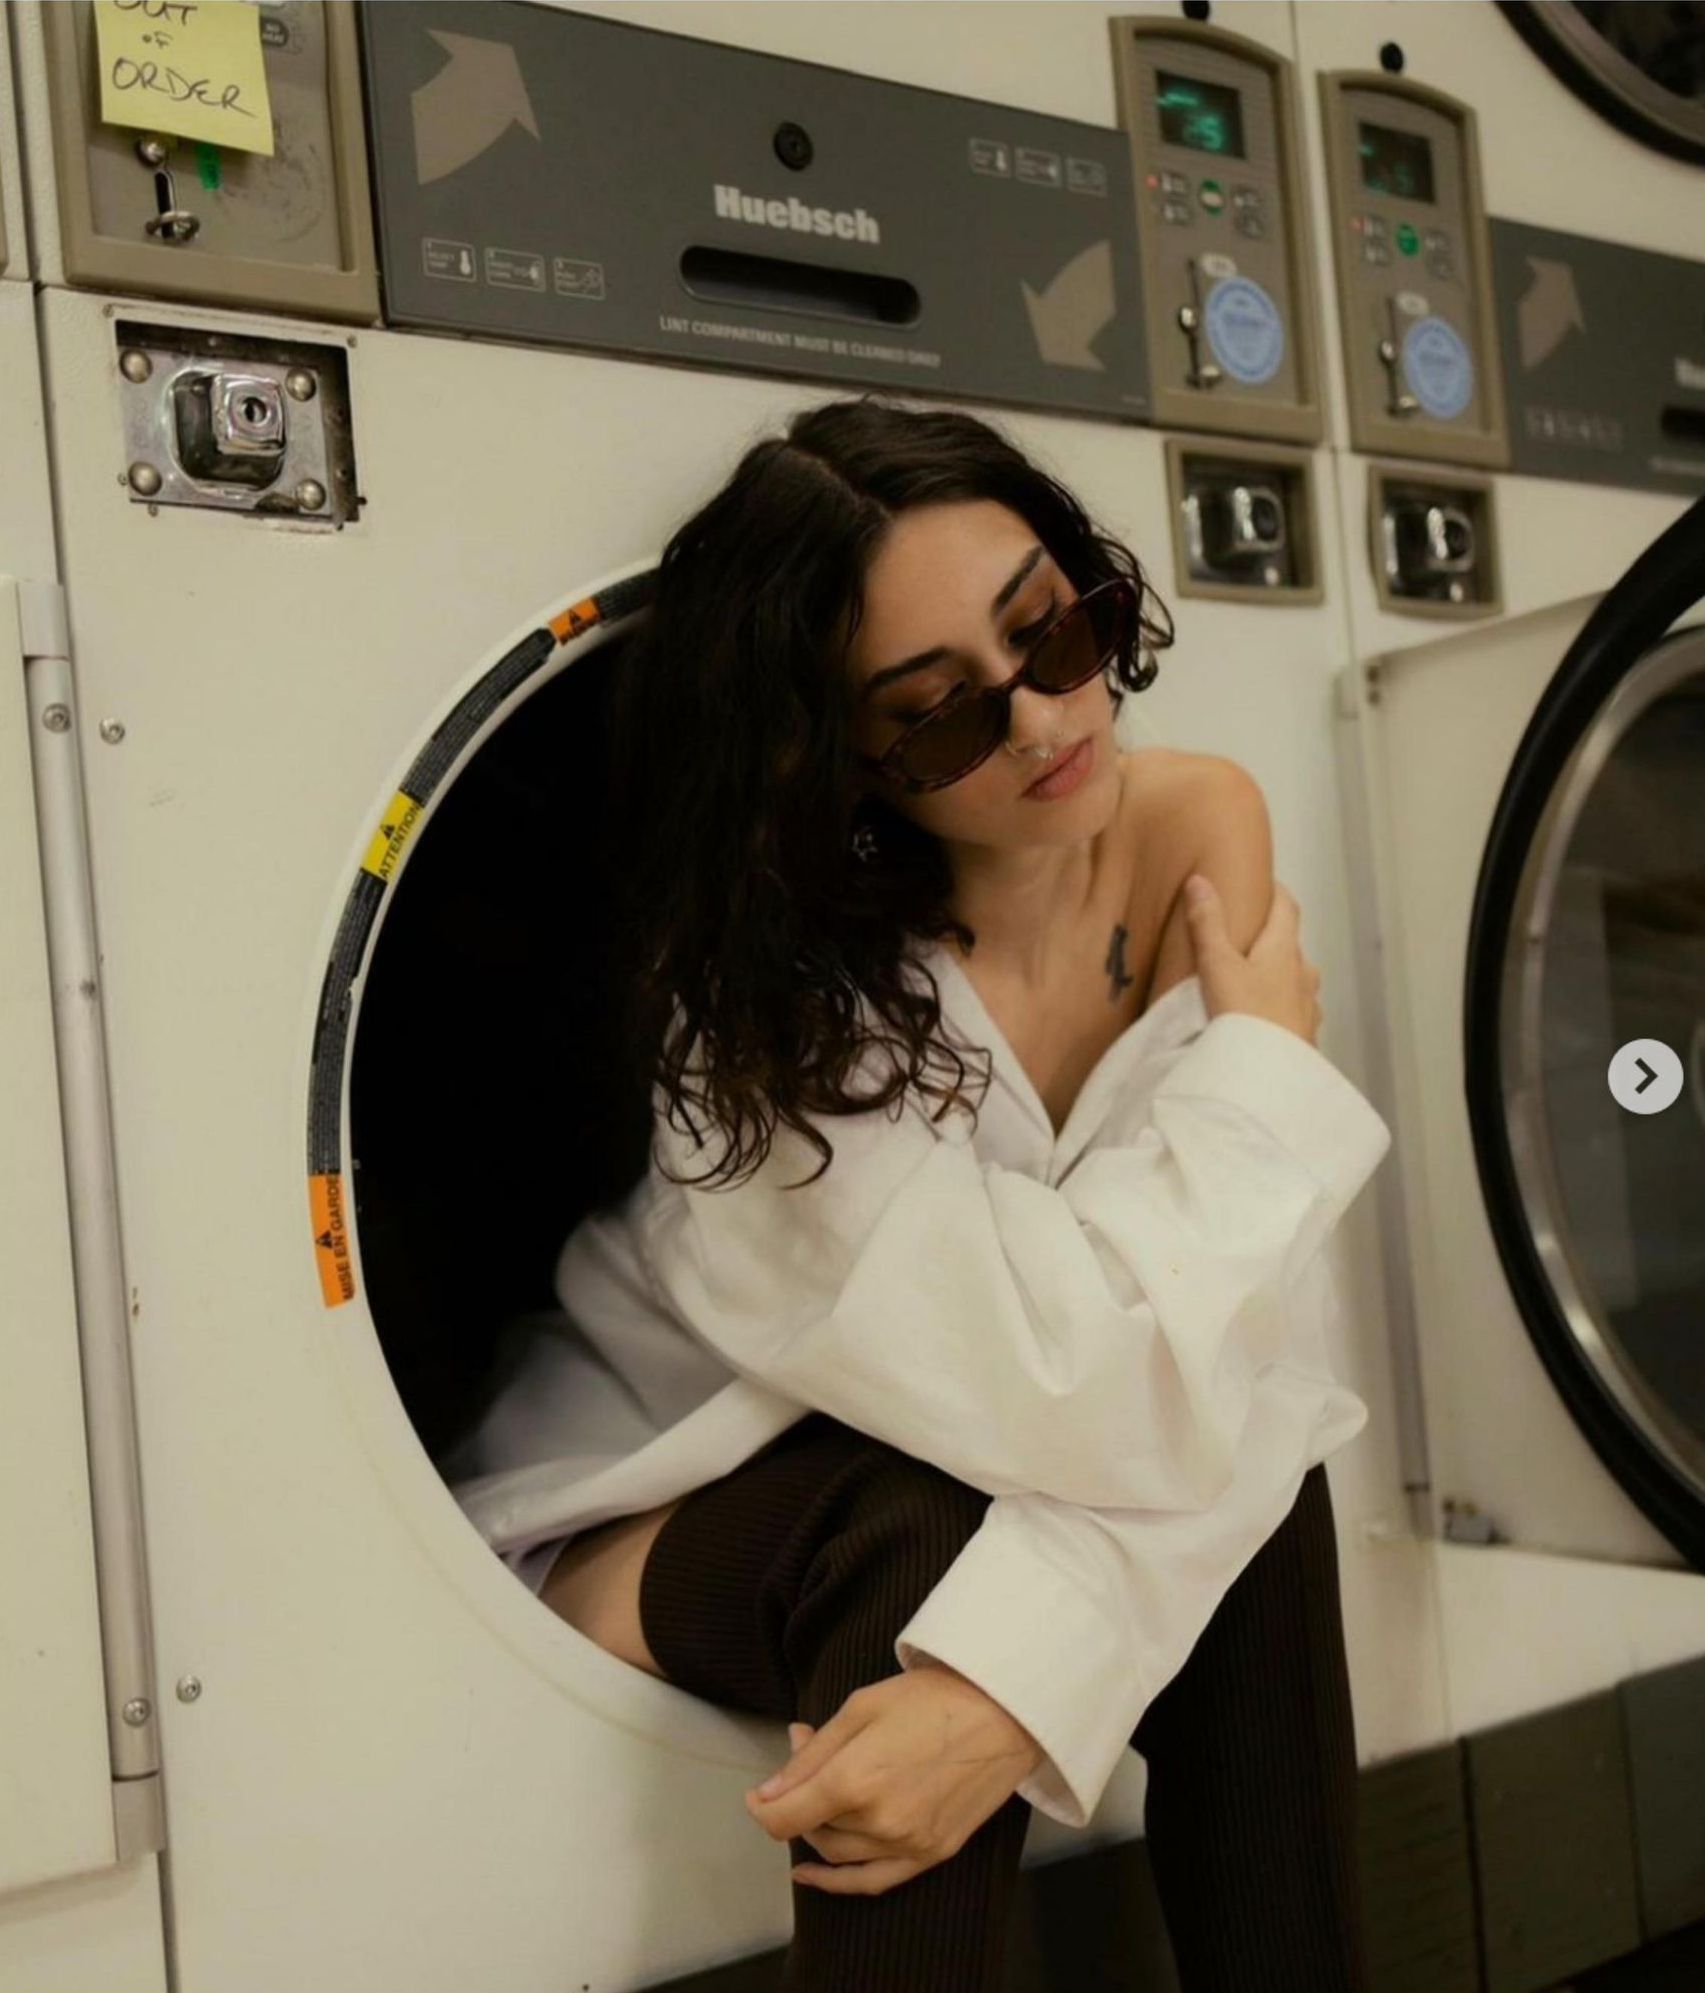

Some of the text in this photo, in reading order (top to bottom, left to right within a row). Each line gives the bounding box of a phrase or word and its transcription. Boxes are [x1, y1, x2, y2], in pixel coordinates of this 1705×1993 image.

[142, 31, 173, 49] OF
[112, 57, 256, 118] ORDER
[713, 184, 881, 245] Huebsch
[659, 316, 689, 333] LINT
[691, 320, 792, 348] COMPARTMENT
[794, 335, 830, 353] MUST
[378, 801, 423, 878] ATTENTION
[325, 1175, 355, 1301] MISE EN GARDE
